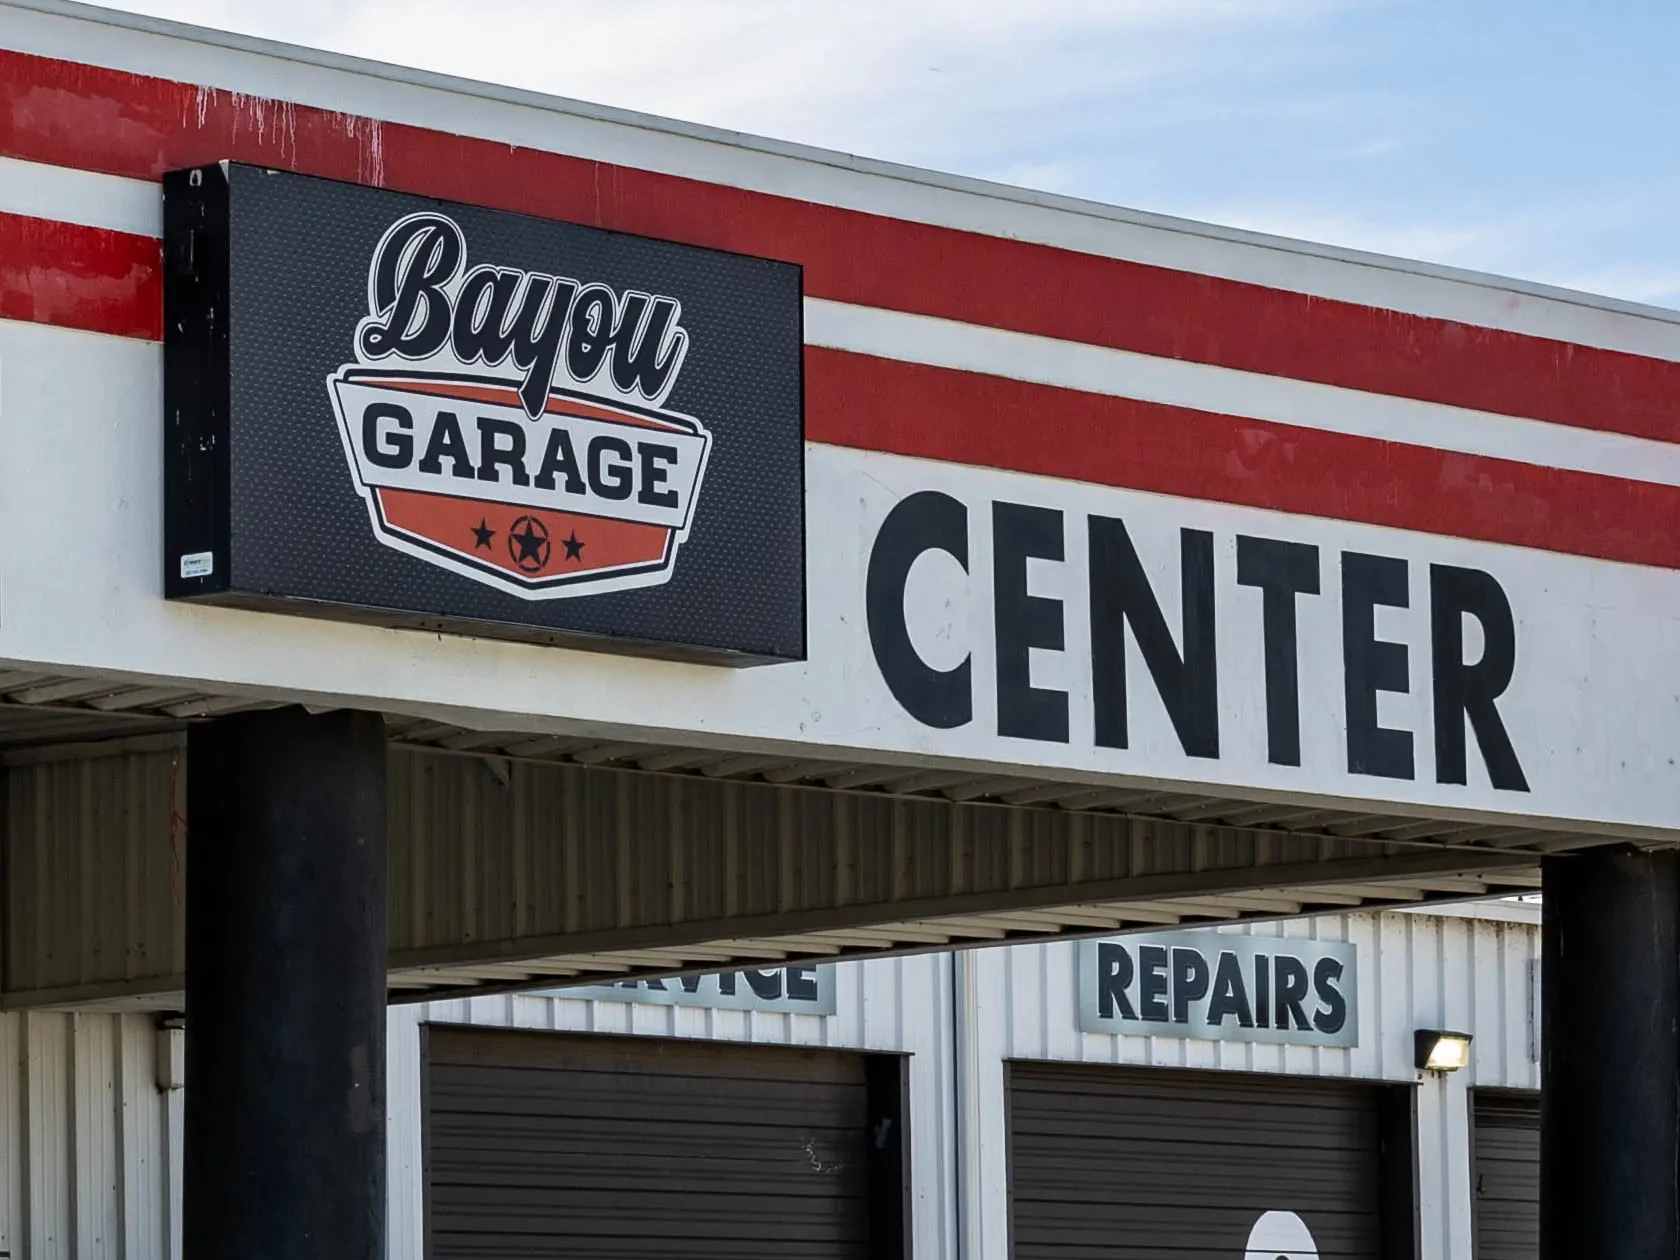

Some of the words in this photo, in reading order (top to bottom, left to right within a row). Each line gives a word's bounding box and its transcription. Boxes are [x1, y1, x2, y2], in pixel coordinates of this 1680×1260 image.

[359, 213, 686, 421] Bayou
[361, 402, 679, 509] GARAGE
[866, 491, 1531, 793] CENTER
[1096, 941, 1347, 1034] REPAIRS
